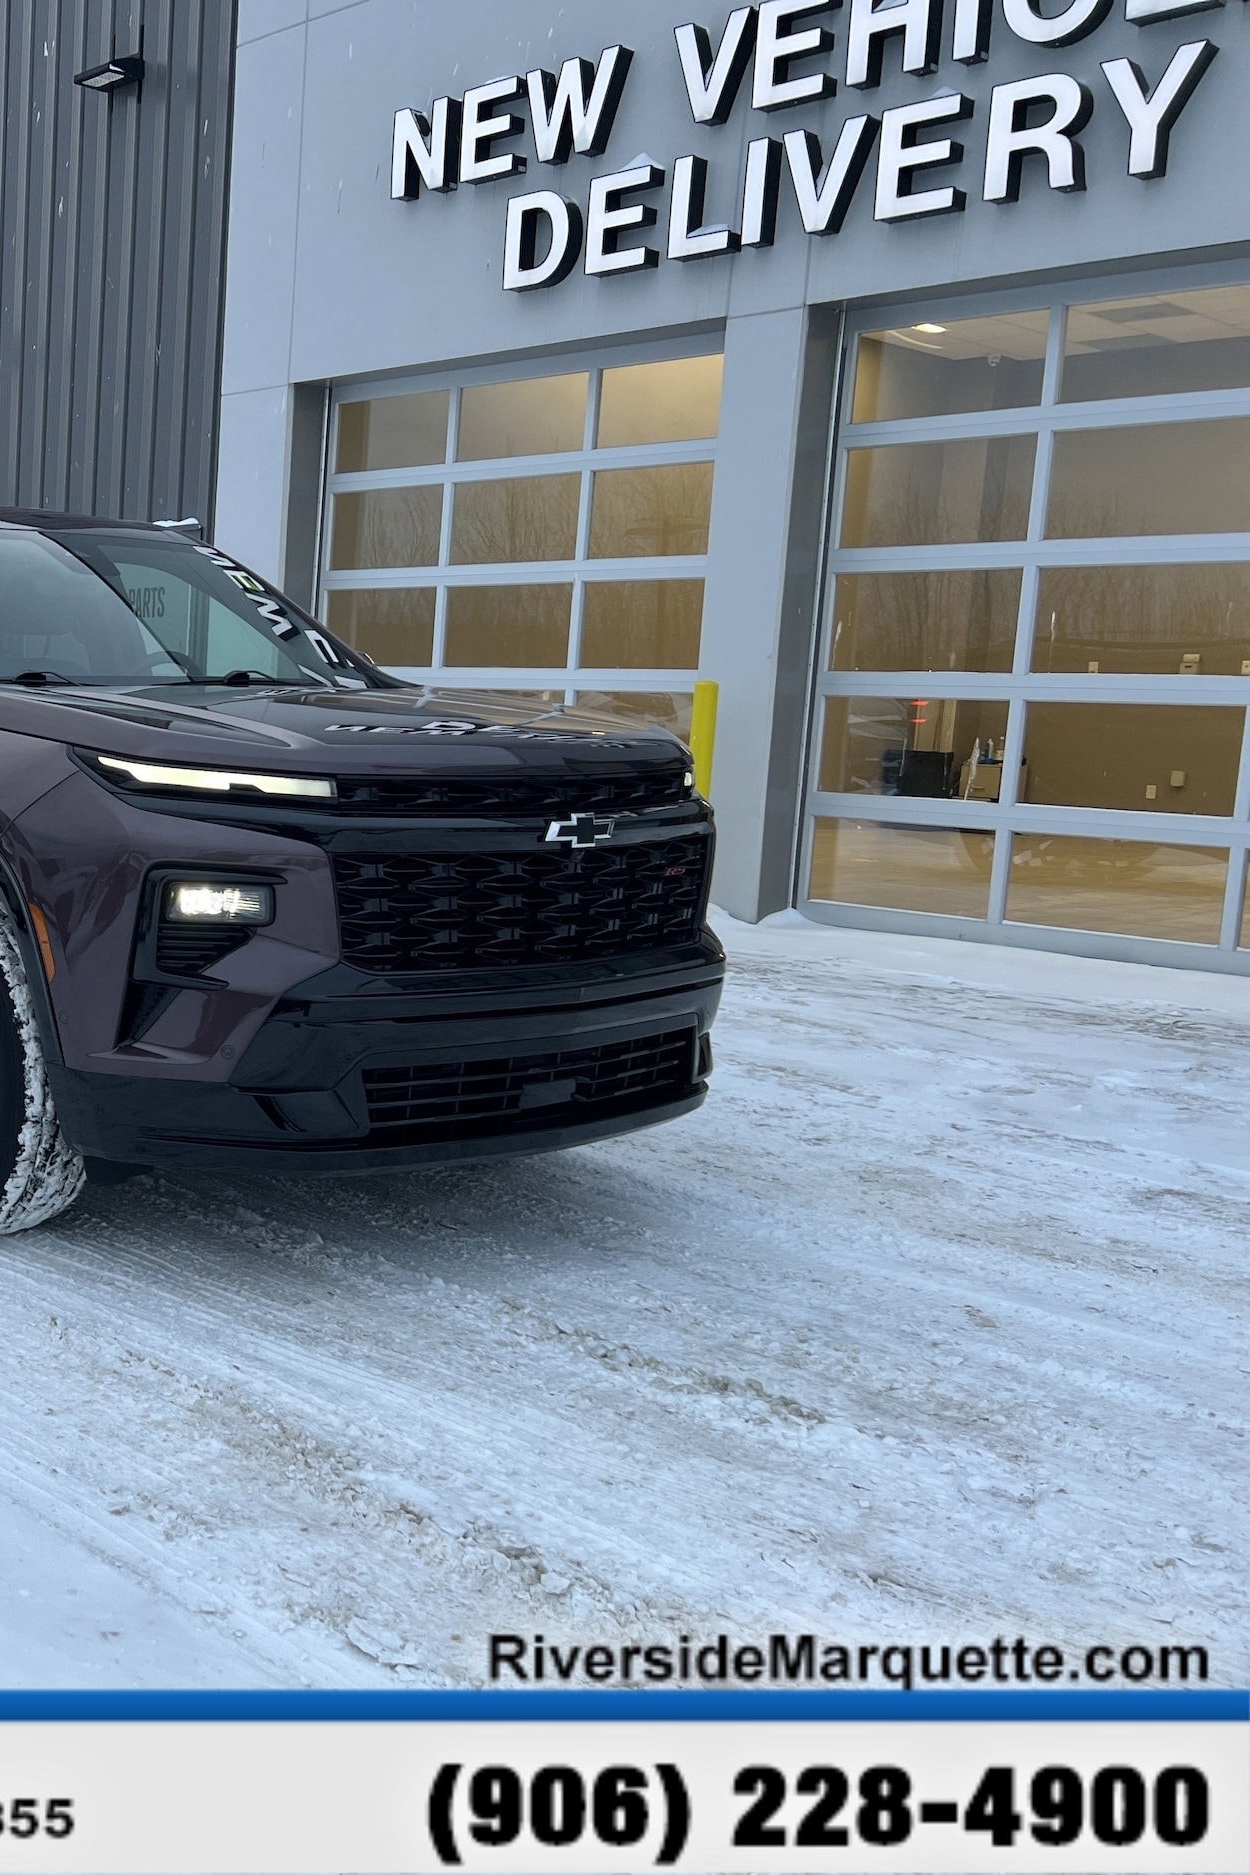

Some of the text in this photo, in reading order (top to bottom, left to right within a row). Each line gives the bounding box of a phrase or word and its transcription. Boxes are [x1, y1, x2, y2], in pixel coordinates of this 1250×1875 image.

[390, 0, 1250, 201] NEW VEHI
[502, 40, 1220, 292] DELIVERY
[128, 586, 165, 618] PARTS
